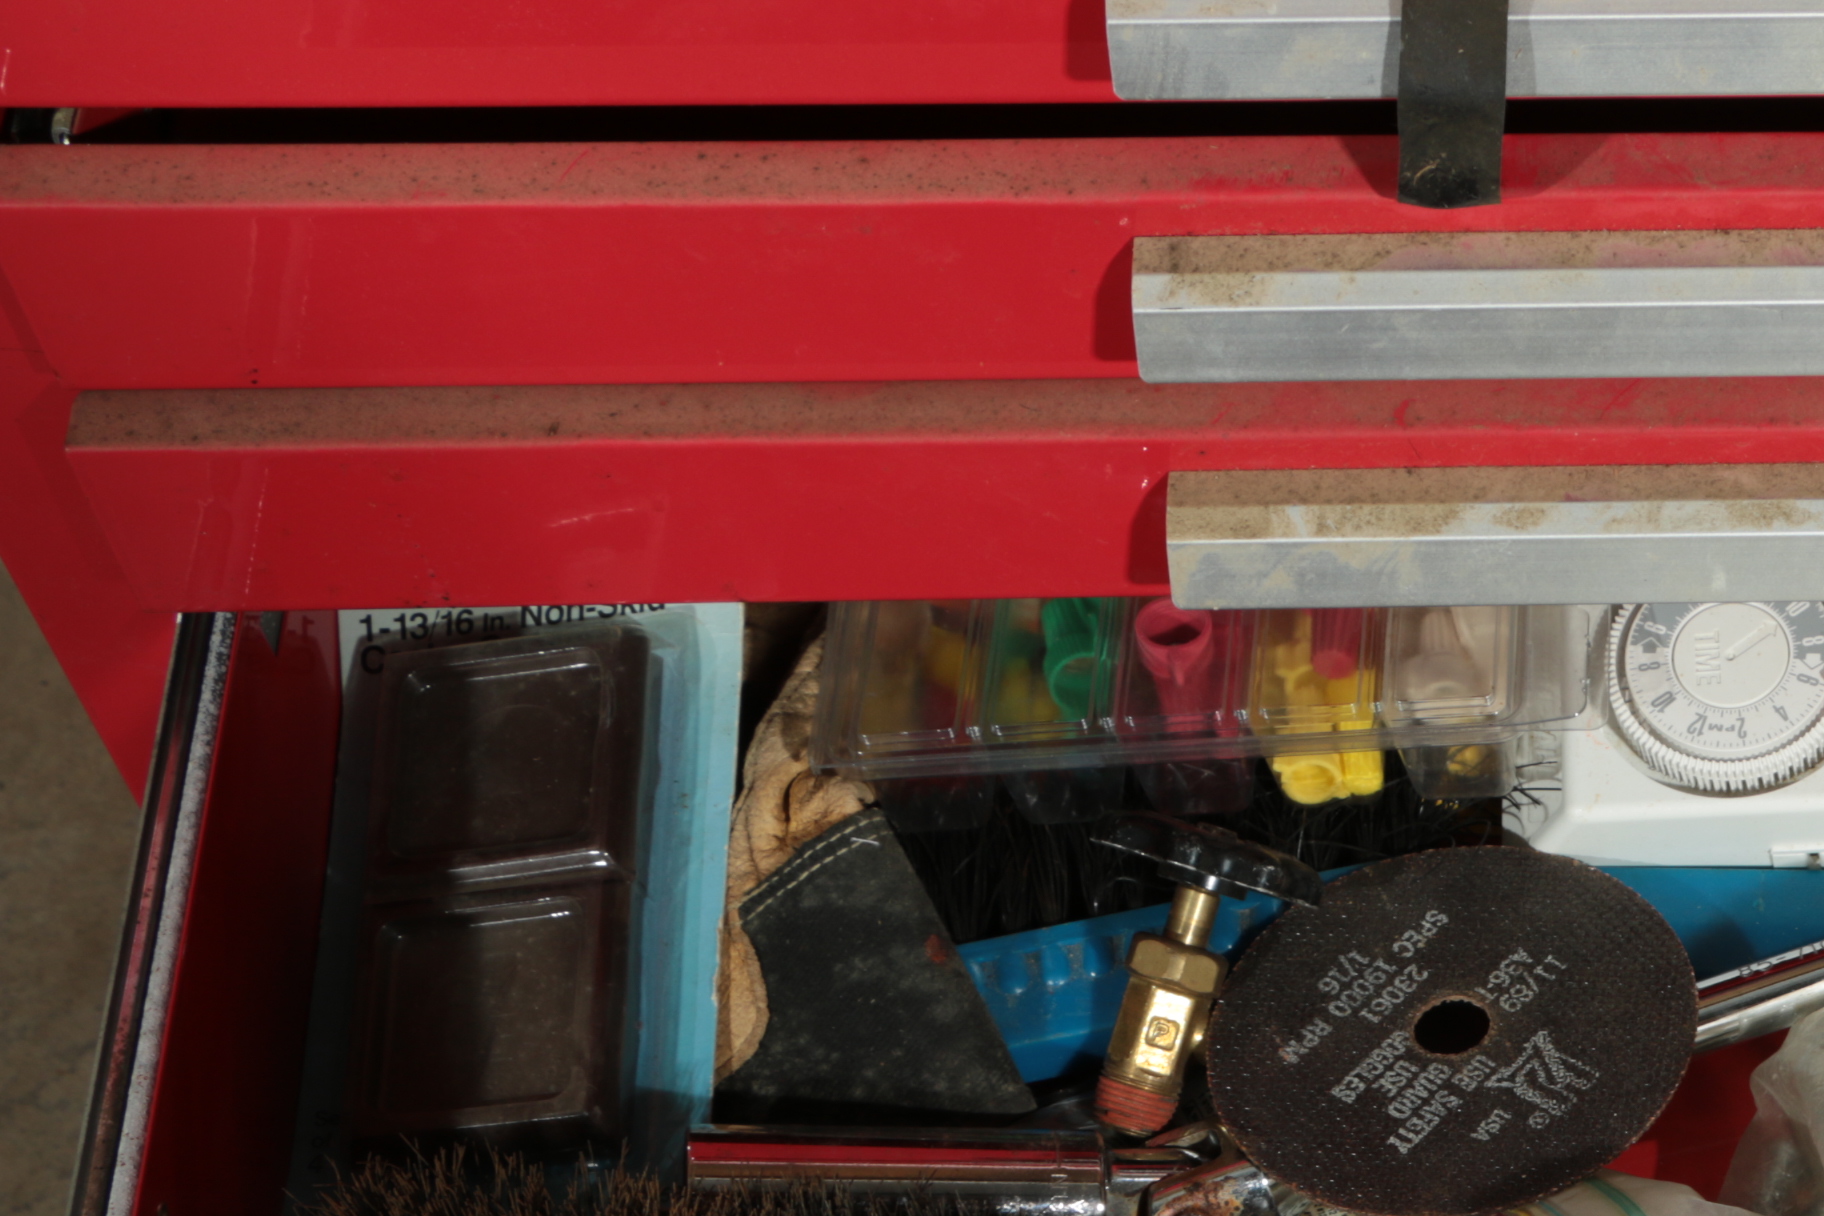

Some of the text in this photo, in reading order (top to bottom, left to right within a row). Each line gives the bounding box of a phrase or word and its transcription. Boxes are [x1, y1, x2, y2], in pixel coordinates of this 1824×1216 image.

[359, 609, 474, 642] 1-13/16
[1695, 627, 1722, 686] TIME
[1650, 690, 1676, 713] 10
[1772, 705, 1788, 721] 4
[1275, 903, 1450, 1069] SPEC 19000 RPM
[1311, 941, 1371, 1000] 1/16
[1357, 957, 1430, 1030] 23061
[1329, 1023, 1414, 1108] GOGGLES
[1371, 1053, 1419, 1102] USE
[1384, 1056, 1453, 1124] GUARD
[1385, 1049, 1496, 1160] USE SAFETY
[1469, 1104, 1512, 1147] USA
